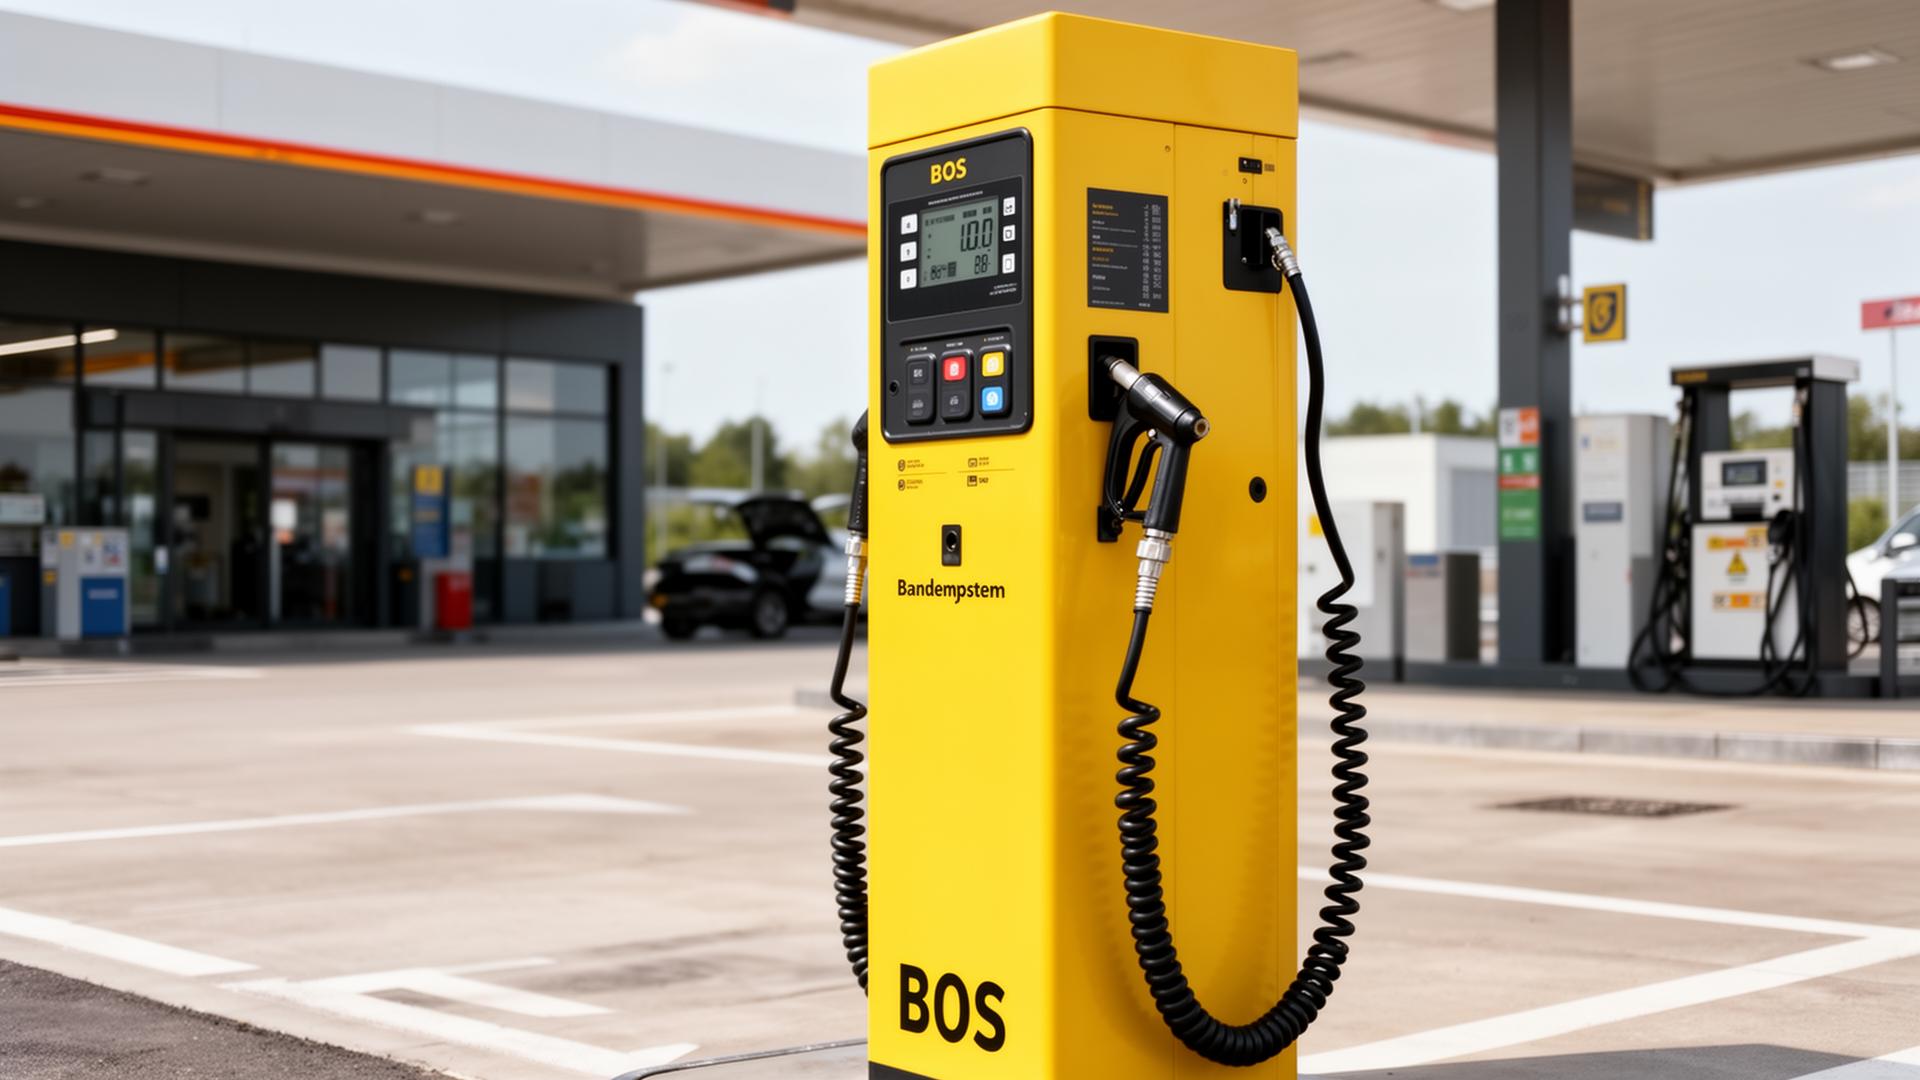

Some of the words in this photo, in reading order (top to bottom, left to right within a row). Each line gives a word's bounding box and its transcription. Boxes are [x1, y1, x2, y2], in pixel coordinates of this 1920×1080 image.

[930, 157, 967, 184] BOS
[897, 578, 1005, 604] Bandempstem
[900, 963, 1006, 1053] BOS
